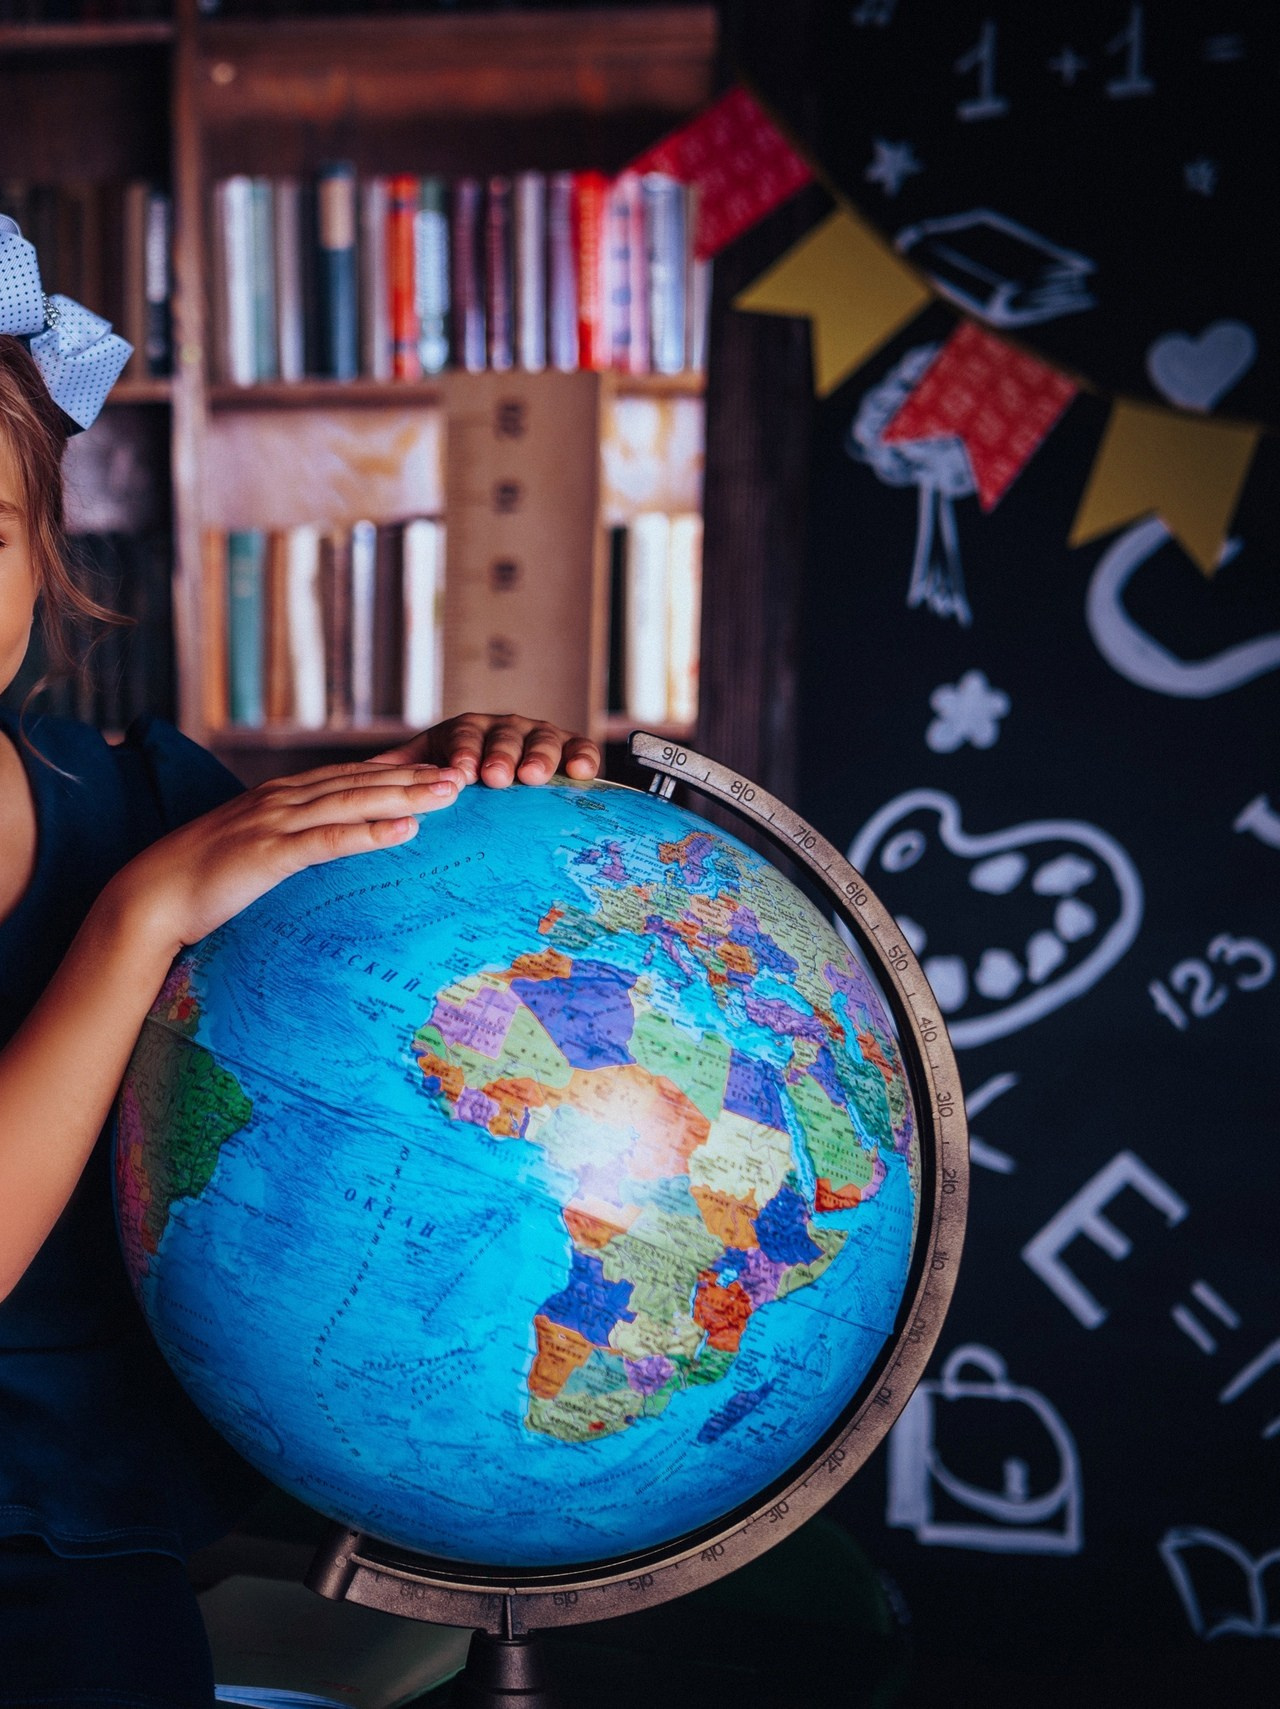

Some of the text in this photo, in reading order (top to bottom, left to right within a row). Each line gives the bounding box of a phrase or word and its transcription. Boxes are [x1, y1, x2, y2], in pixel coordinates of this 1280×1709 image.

[953, 17, 1009, 123] 1
[1104, 3, 1156, 98] 1
[1147, 932, 1277, 1032] 123
[1020, 1149, 1190, 1331] E
